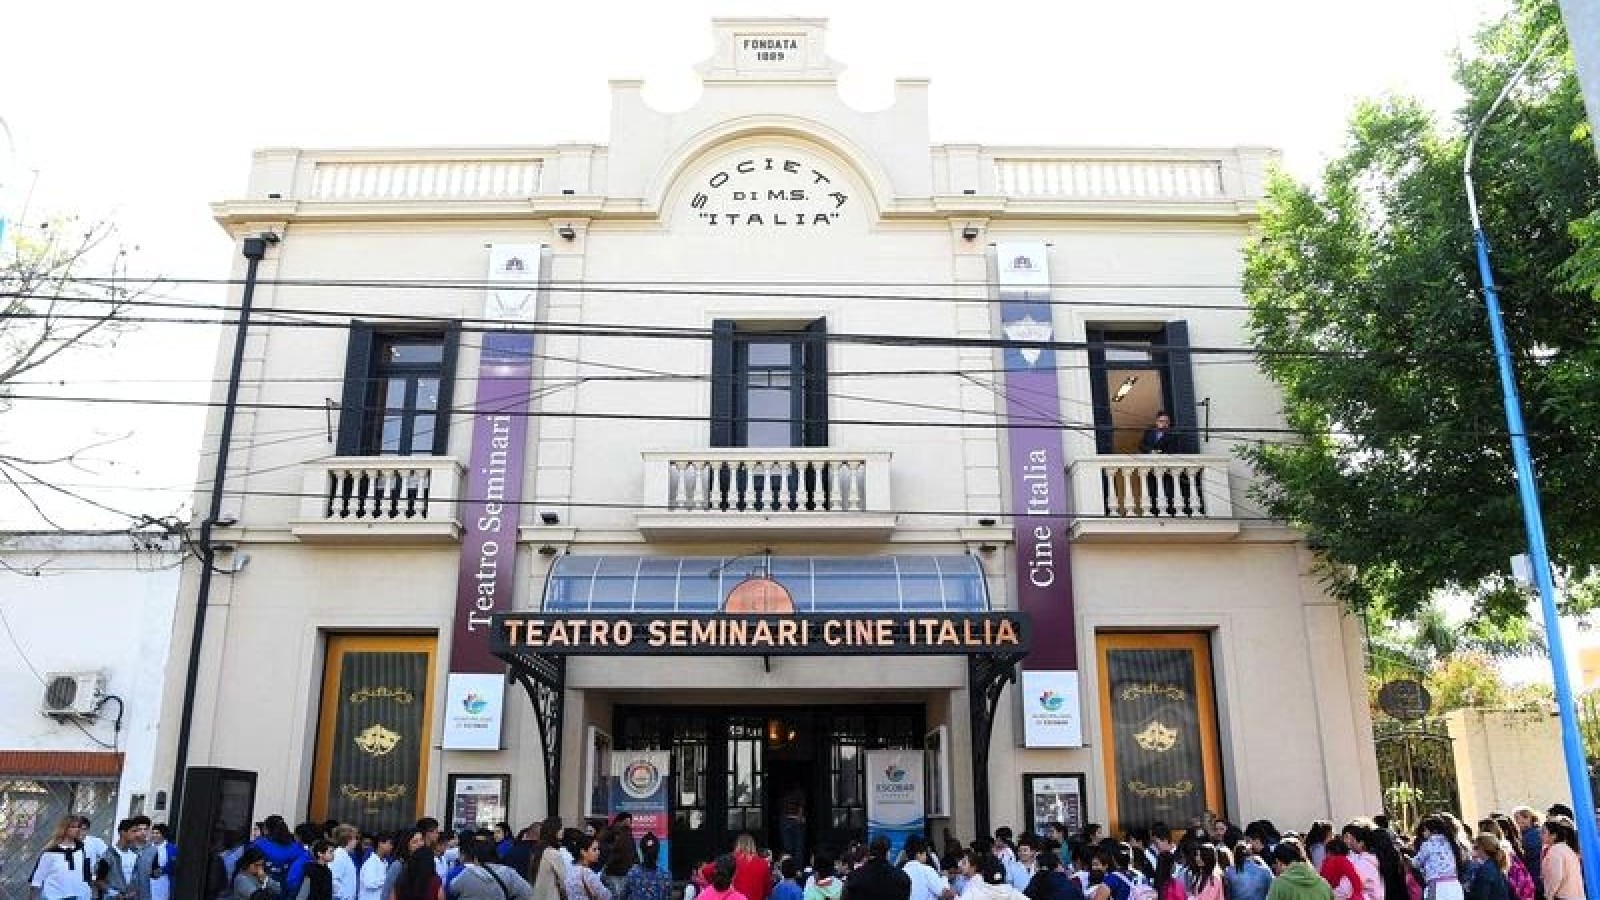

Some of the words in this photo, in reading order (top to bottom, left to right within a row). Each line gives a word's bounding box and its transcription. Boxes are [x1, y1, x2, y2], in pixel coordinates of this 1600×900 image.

[743, 39, 798, 50] FONDATA
[691, 157, 848, 209] SOCIETA
[733, 191, 758, 201] DI
[767, 189, 808, 201] M.S.
[699, 212, 840, 226] "ITALIA"
[477, 414, 511, 533] Seminari
[1023, 447, 1051, 515] Italia
[1028, 526, 1055, 588] Cine
[468, 541, 499, 631] Teatro
[504, 619, 633, 647] TEATRO
[648, 619, 809, 647] SEMINARI
[823, 619, 895, 647] CINE
[908, 619, 1019, 647] ITALIA
